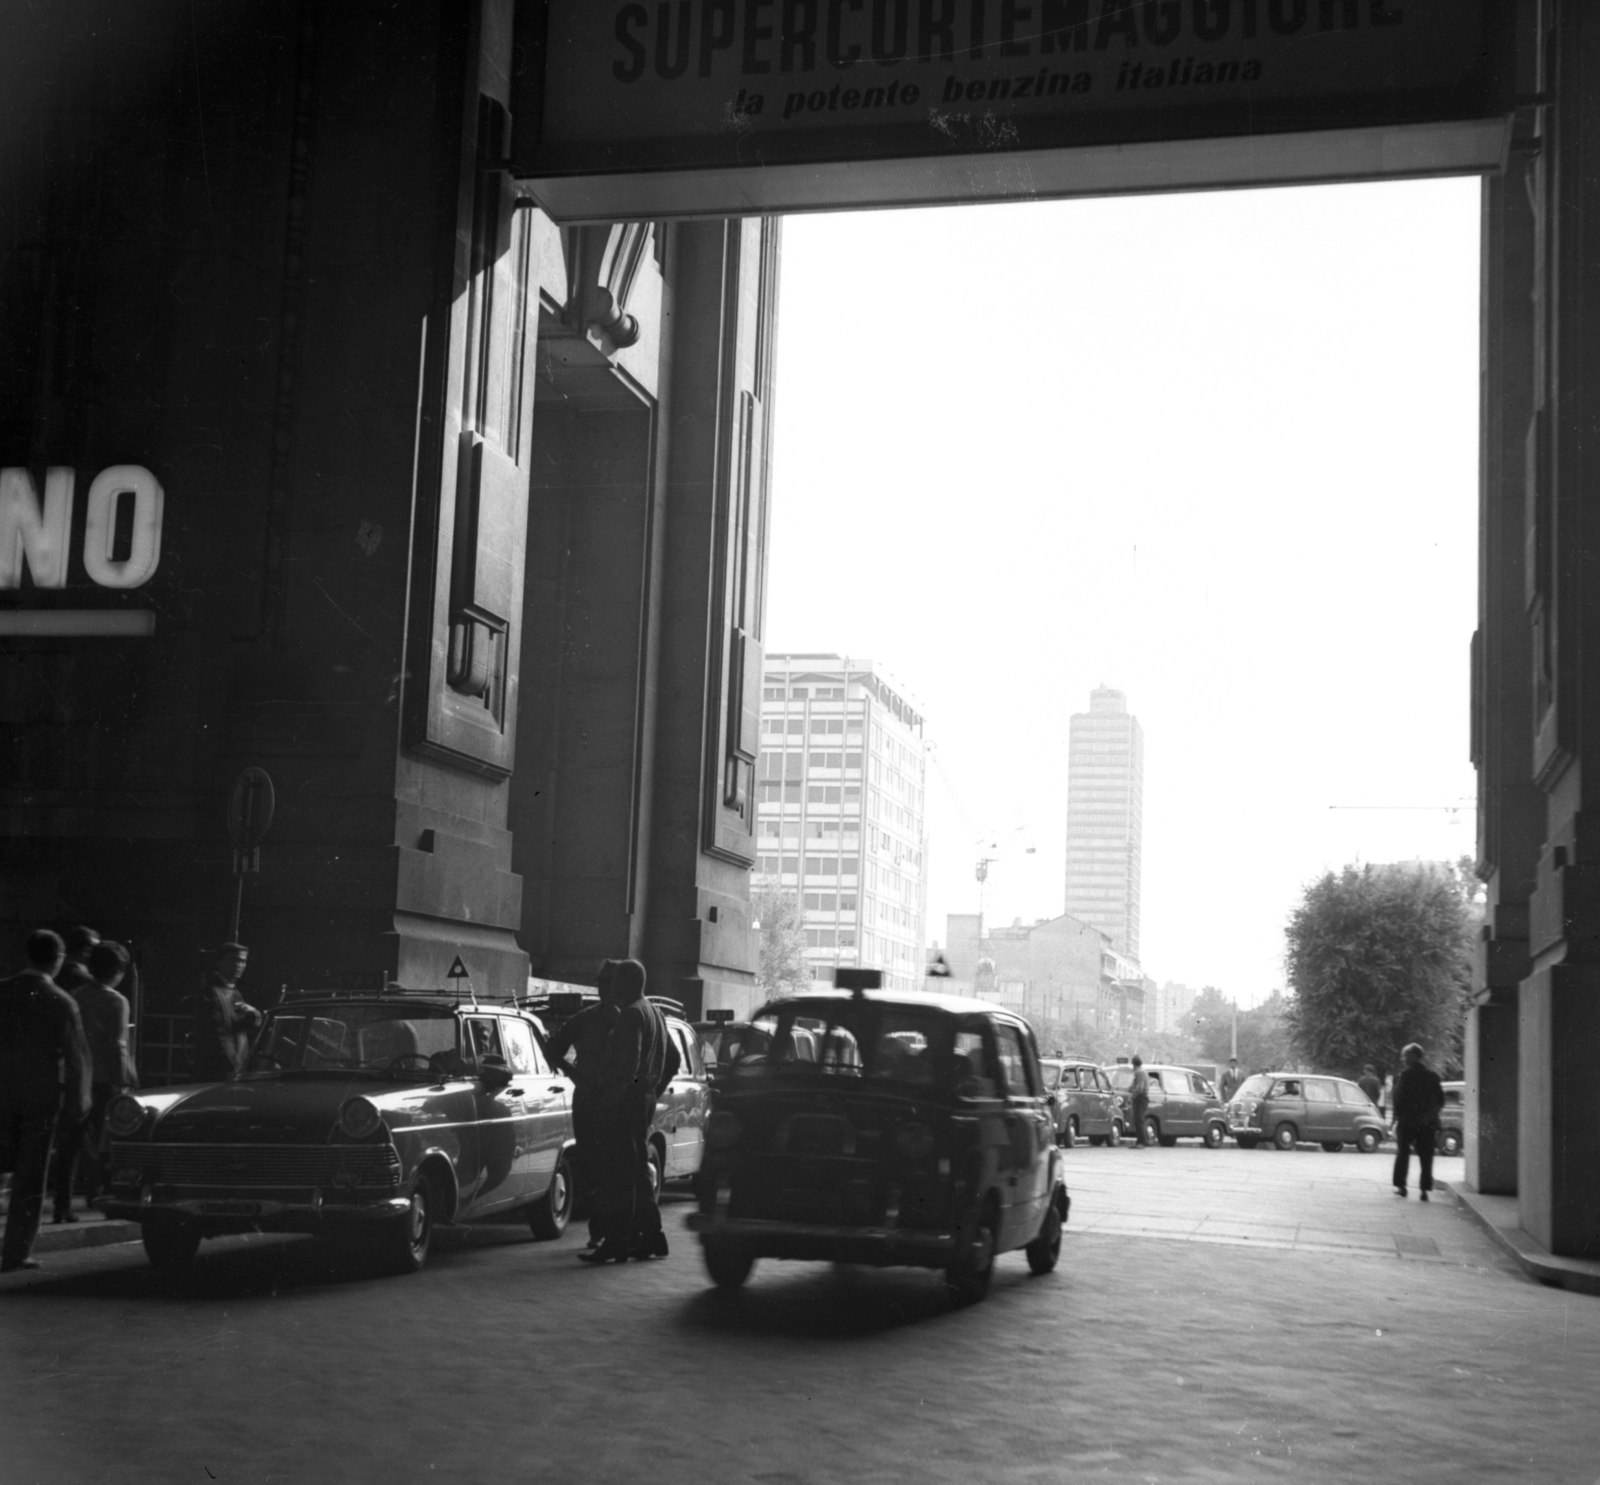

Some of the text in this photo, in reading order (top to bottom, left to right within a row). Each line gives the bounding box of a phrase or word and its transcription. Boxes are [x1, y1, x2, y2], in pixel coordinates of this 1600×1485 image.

[735, 56, 1263, 120] la potente benzina italiana
